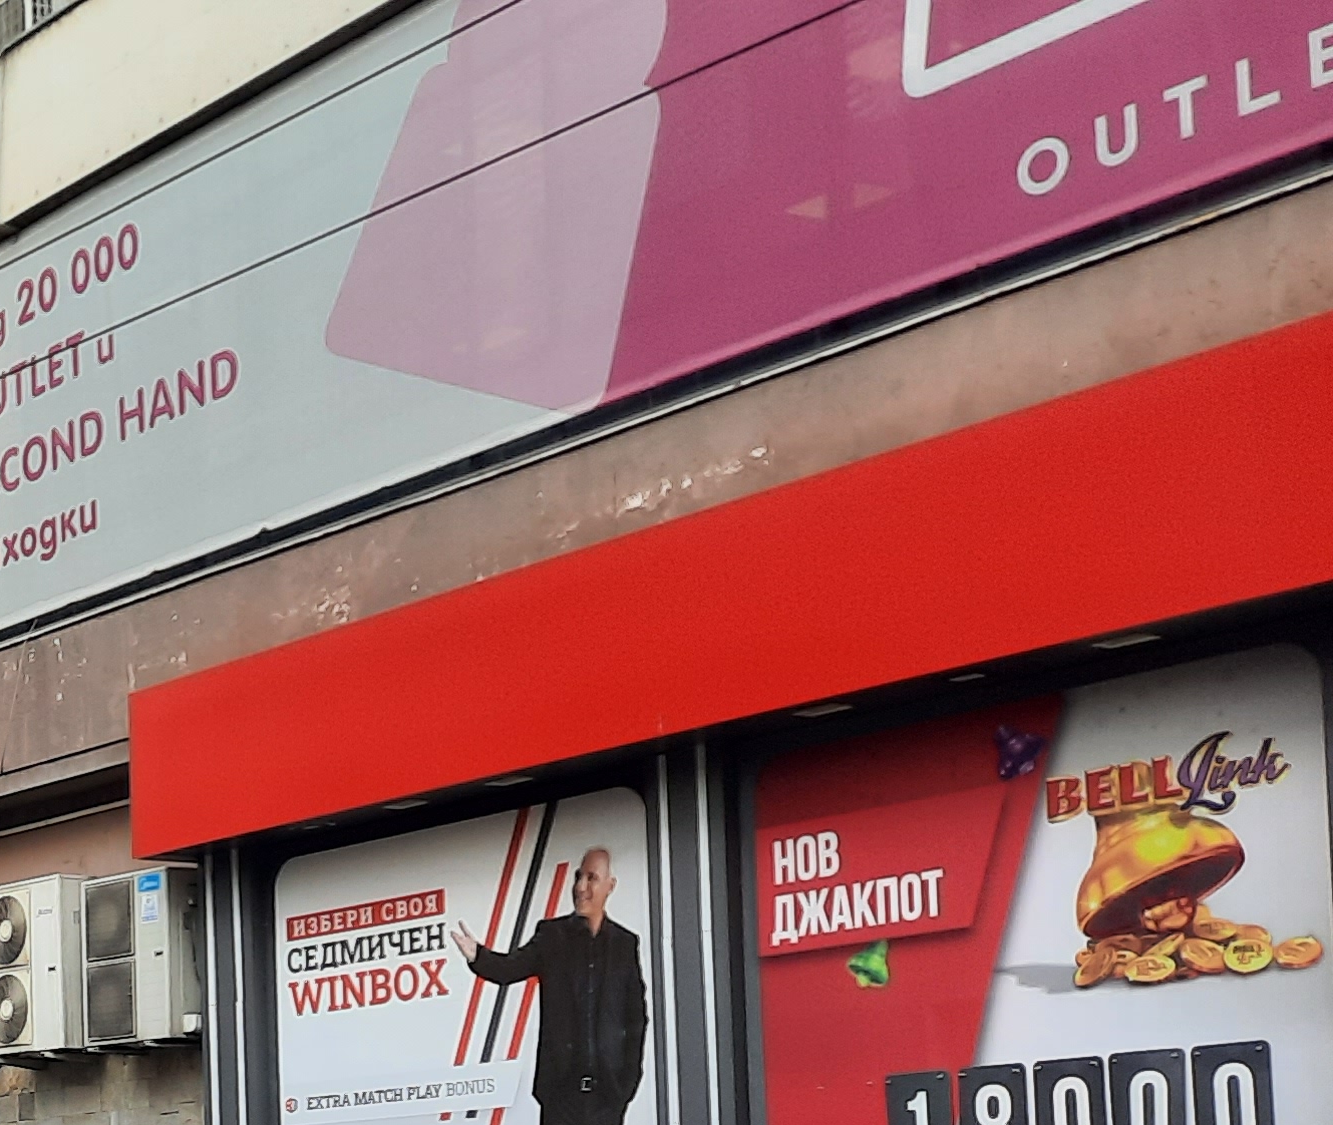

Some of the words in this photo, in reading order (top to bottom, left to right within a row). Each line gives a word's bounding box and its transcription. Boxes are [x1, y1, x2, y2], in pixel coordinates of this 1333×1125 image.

[16, 267, 57, 327] 20
[70, 222, 140, 295] 000
[119, 348, 240, 442] HAND
[1046, 754, 1186, 823] BELL
[1177, 730, 1292, 812] Link
[771, 829, 841, 885] НОВ
[291, 905, 374, 938] ИЗБЕРИ
[381, 893, 439, 921] СВОЯ
[769, 868, 944, 947] ДЖАКПОТ
[287, 922, 447, 974] СЕДМИЧЕН
[288, 958, 450, 1017] WINBOX
[306, 1093, 352, 1111] EXTRA
[353, 1087, 404, 1106] MATCH
[406, 1083, 443, 1101] PLAY
[445, 1078, 496, 1098] BONUS
